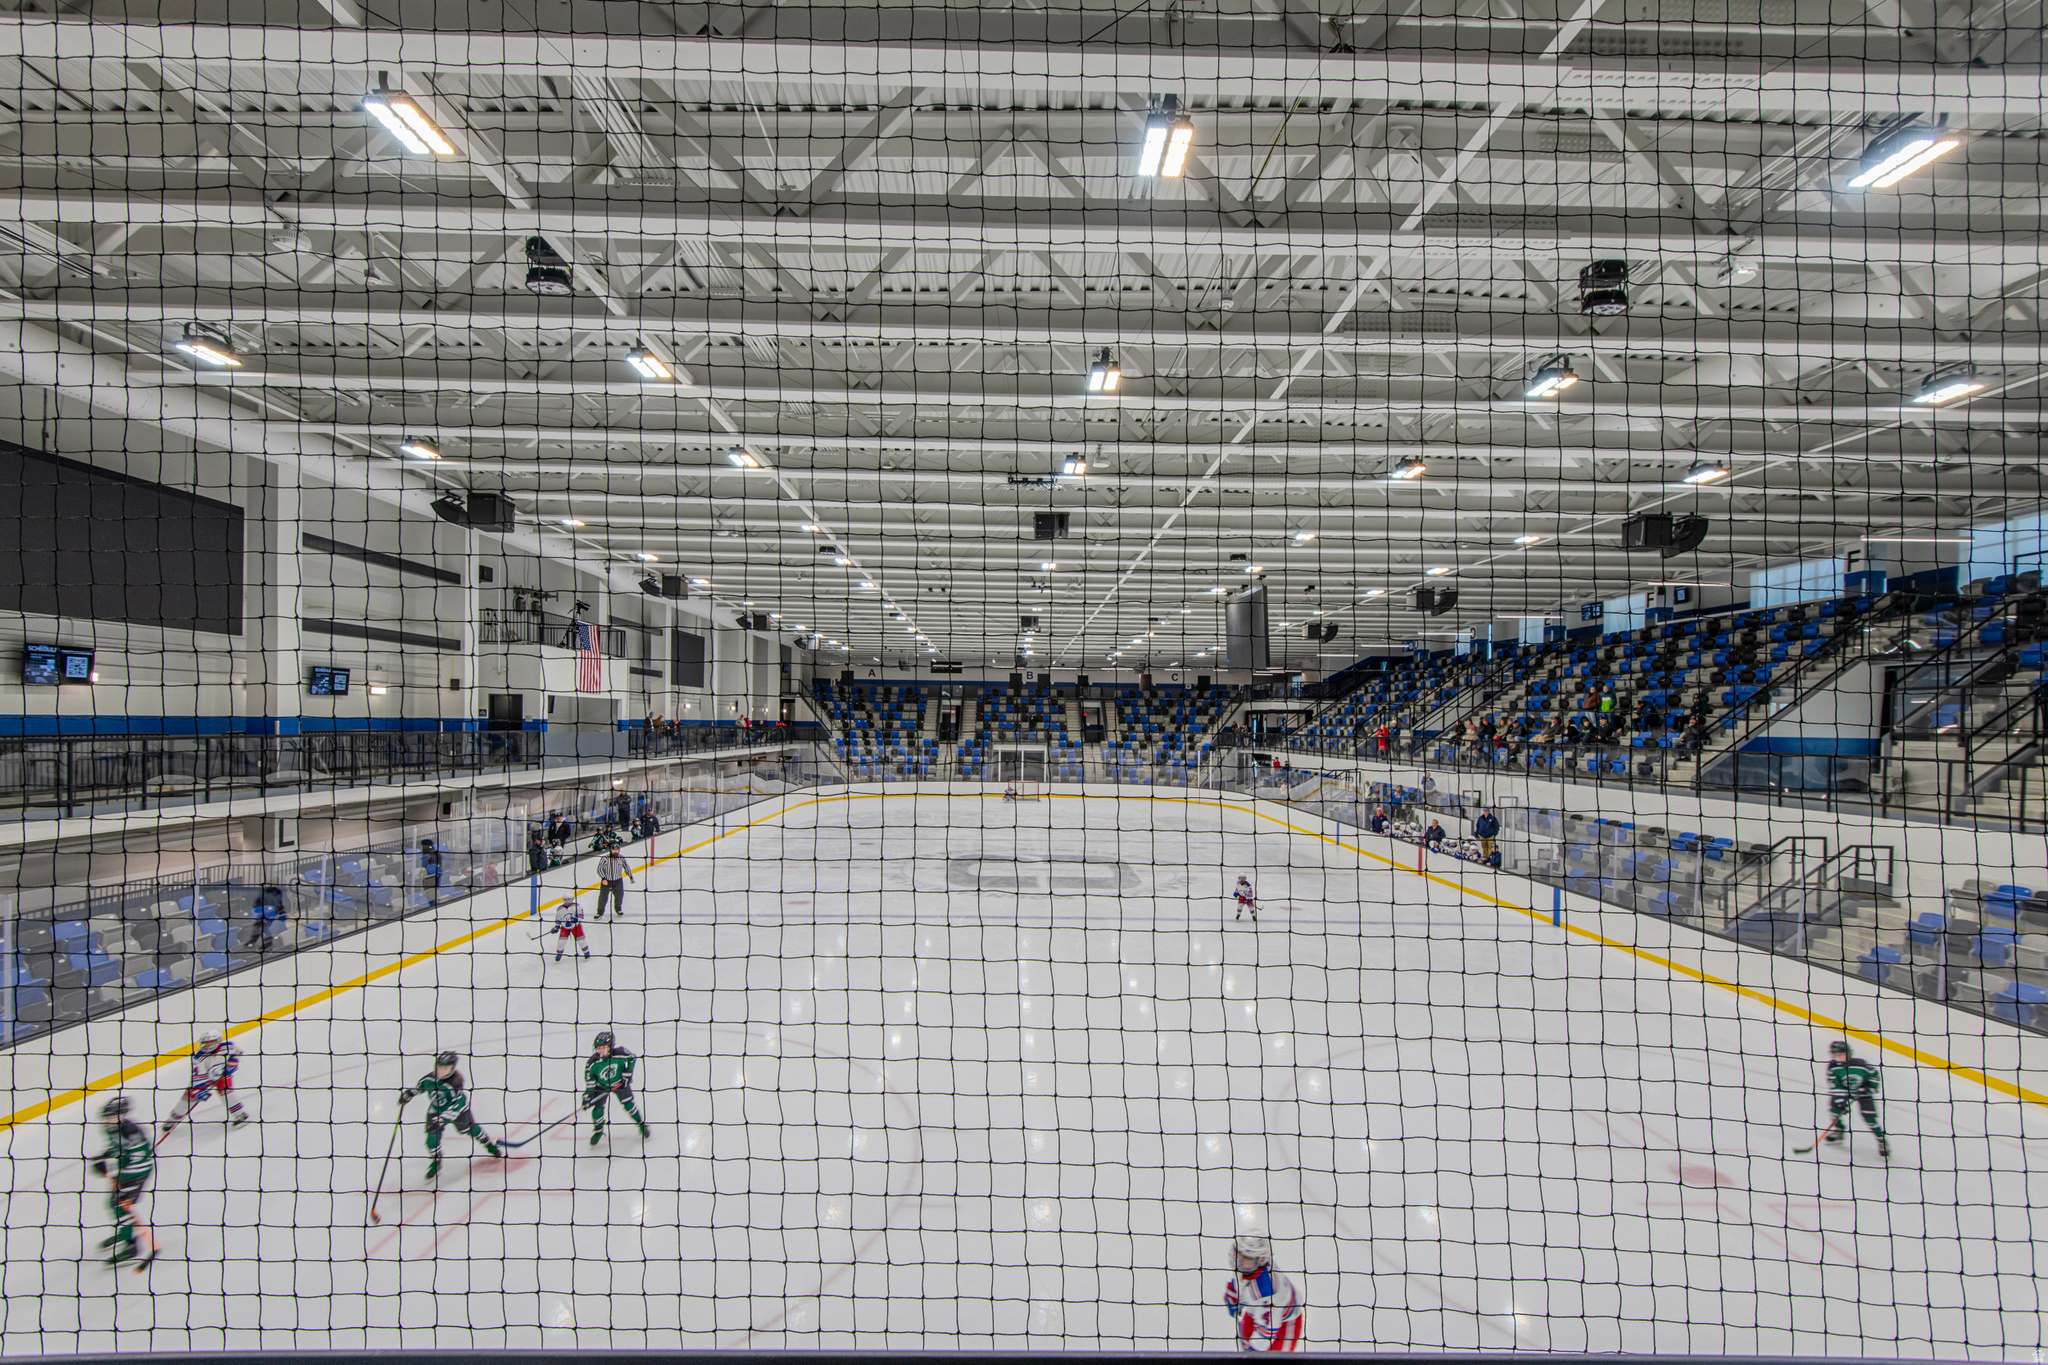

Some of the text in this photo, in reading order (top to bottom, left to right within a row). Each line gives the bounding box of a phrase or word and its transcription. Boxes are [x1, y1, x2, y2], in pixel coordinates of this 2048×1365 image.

[1847, 549, 1861, 573] F
[1646, 591, 1655, 608] F
[868, 668, 876, 677] A
[1026, 671, 1034, 680] B
[1171, 672, 1179, 681] C
[279, 818, 295, 848] L
